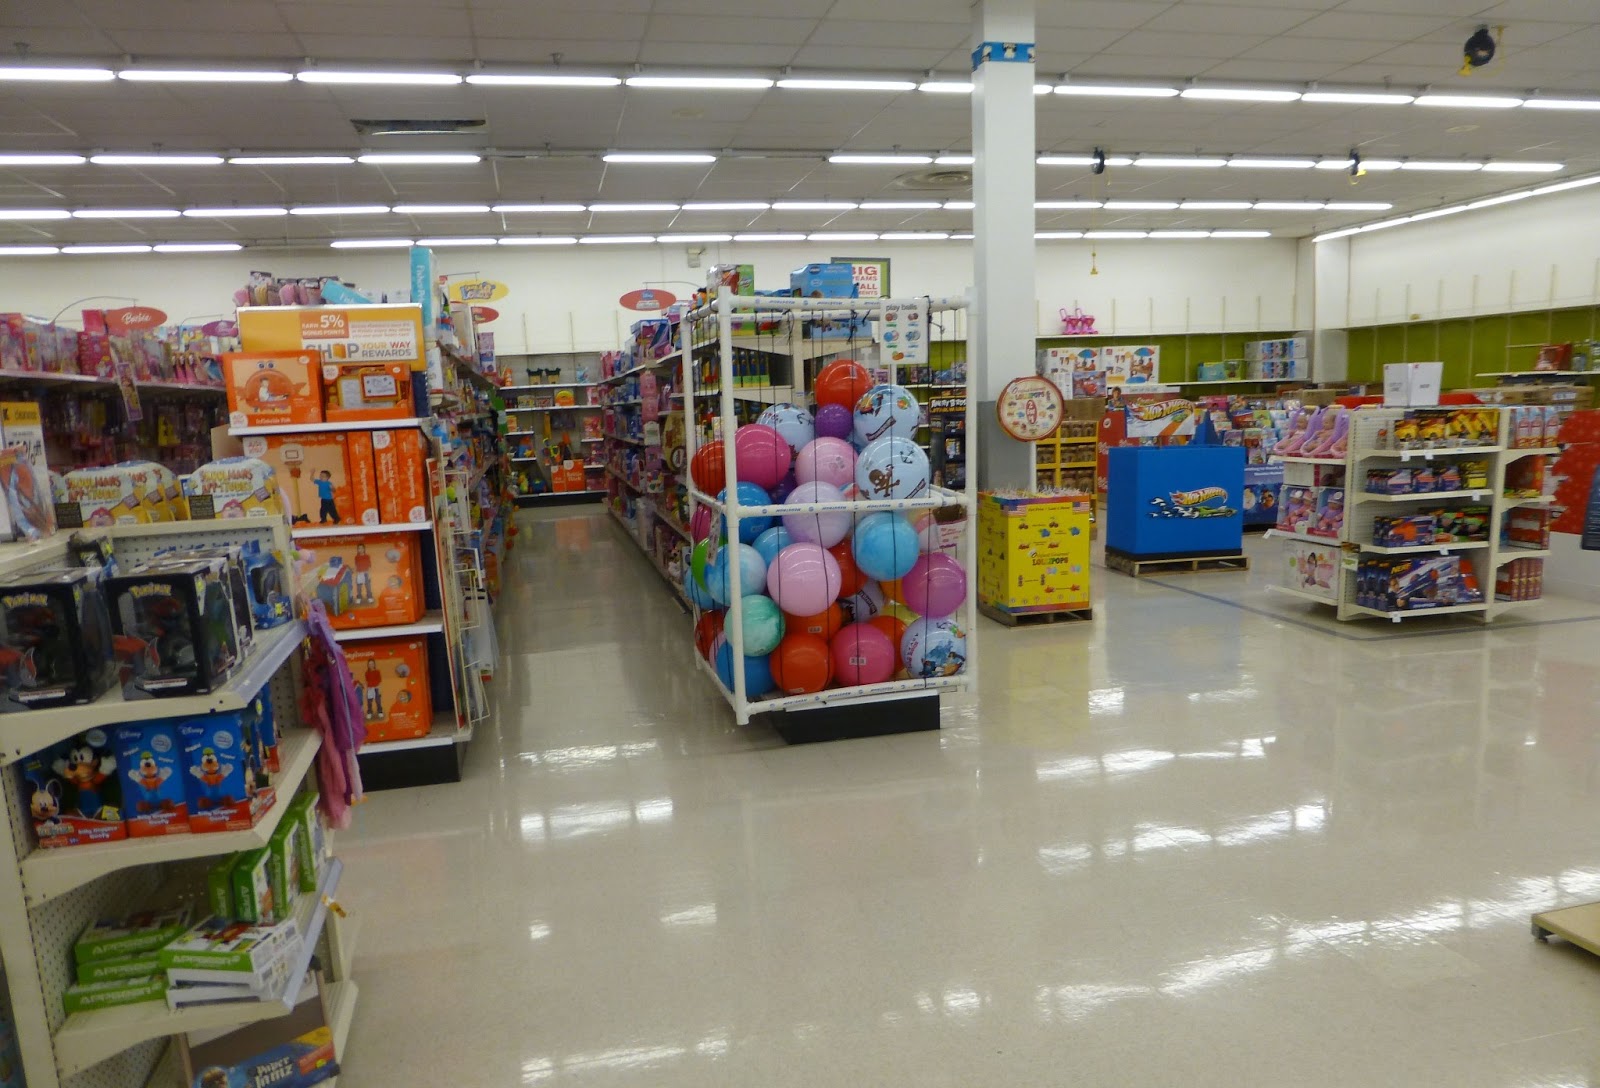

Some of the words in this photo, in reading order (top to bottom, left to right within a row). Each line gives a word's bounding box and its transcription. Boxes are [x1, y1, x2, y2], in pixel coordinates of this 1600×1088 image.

[885, 304, 901, 312] play
[320, 314, 345, 329] 5%
[362, 341, 387, 350] YOUR
[389, 341, 411, 349] WAY
[361, 348, 412, 358] REWARDS
